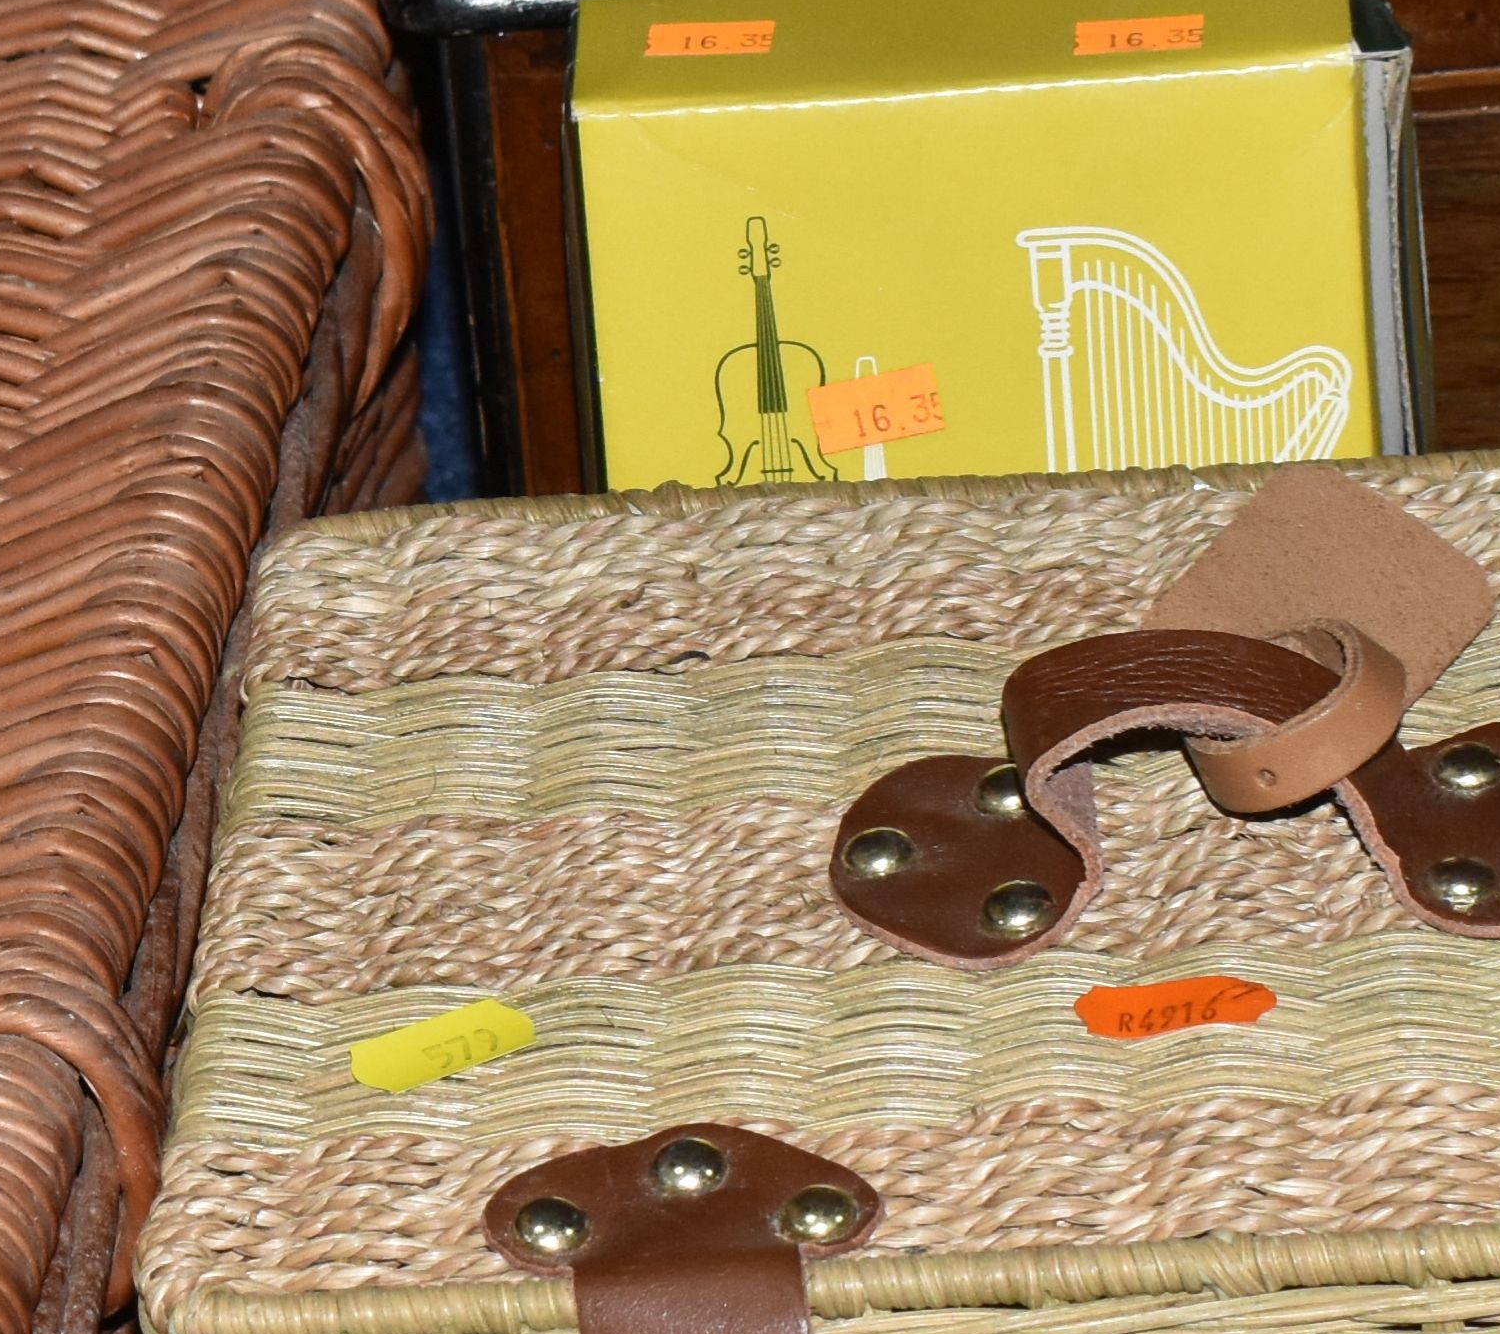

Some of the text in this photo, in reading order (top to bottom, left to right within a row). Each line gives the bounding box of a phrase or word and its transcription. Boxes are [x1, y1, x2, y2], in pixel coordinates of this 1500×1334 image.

[1108, 28, 1204, 48] 16.35
[1117, 989, 1224, 1033] R4916
[421, 1028, 499, 1069] 579
